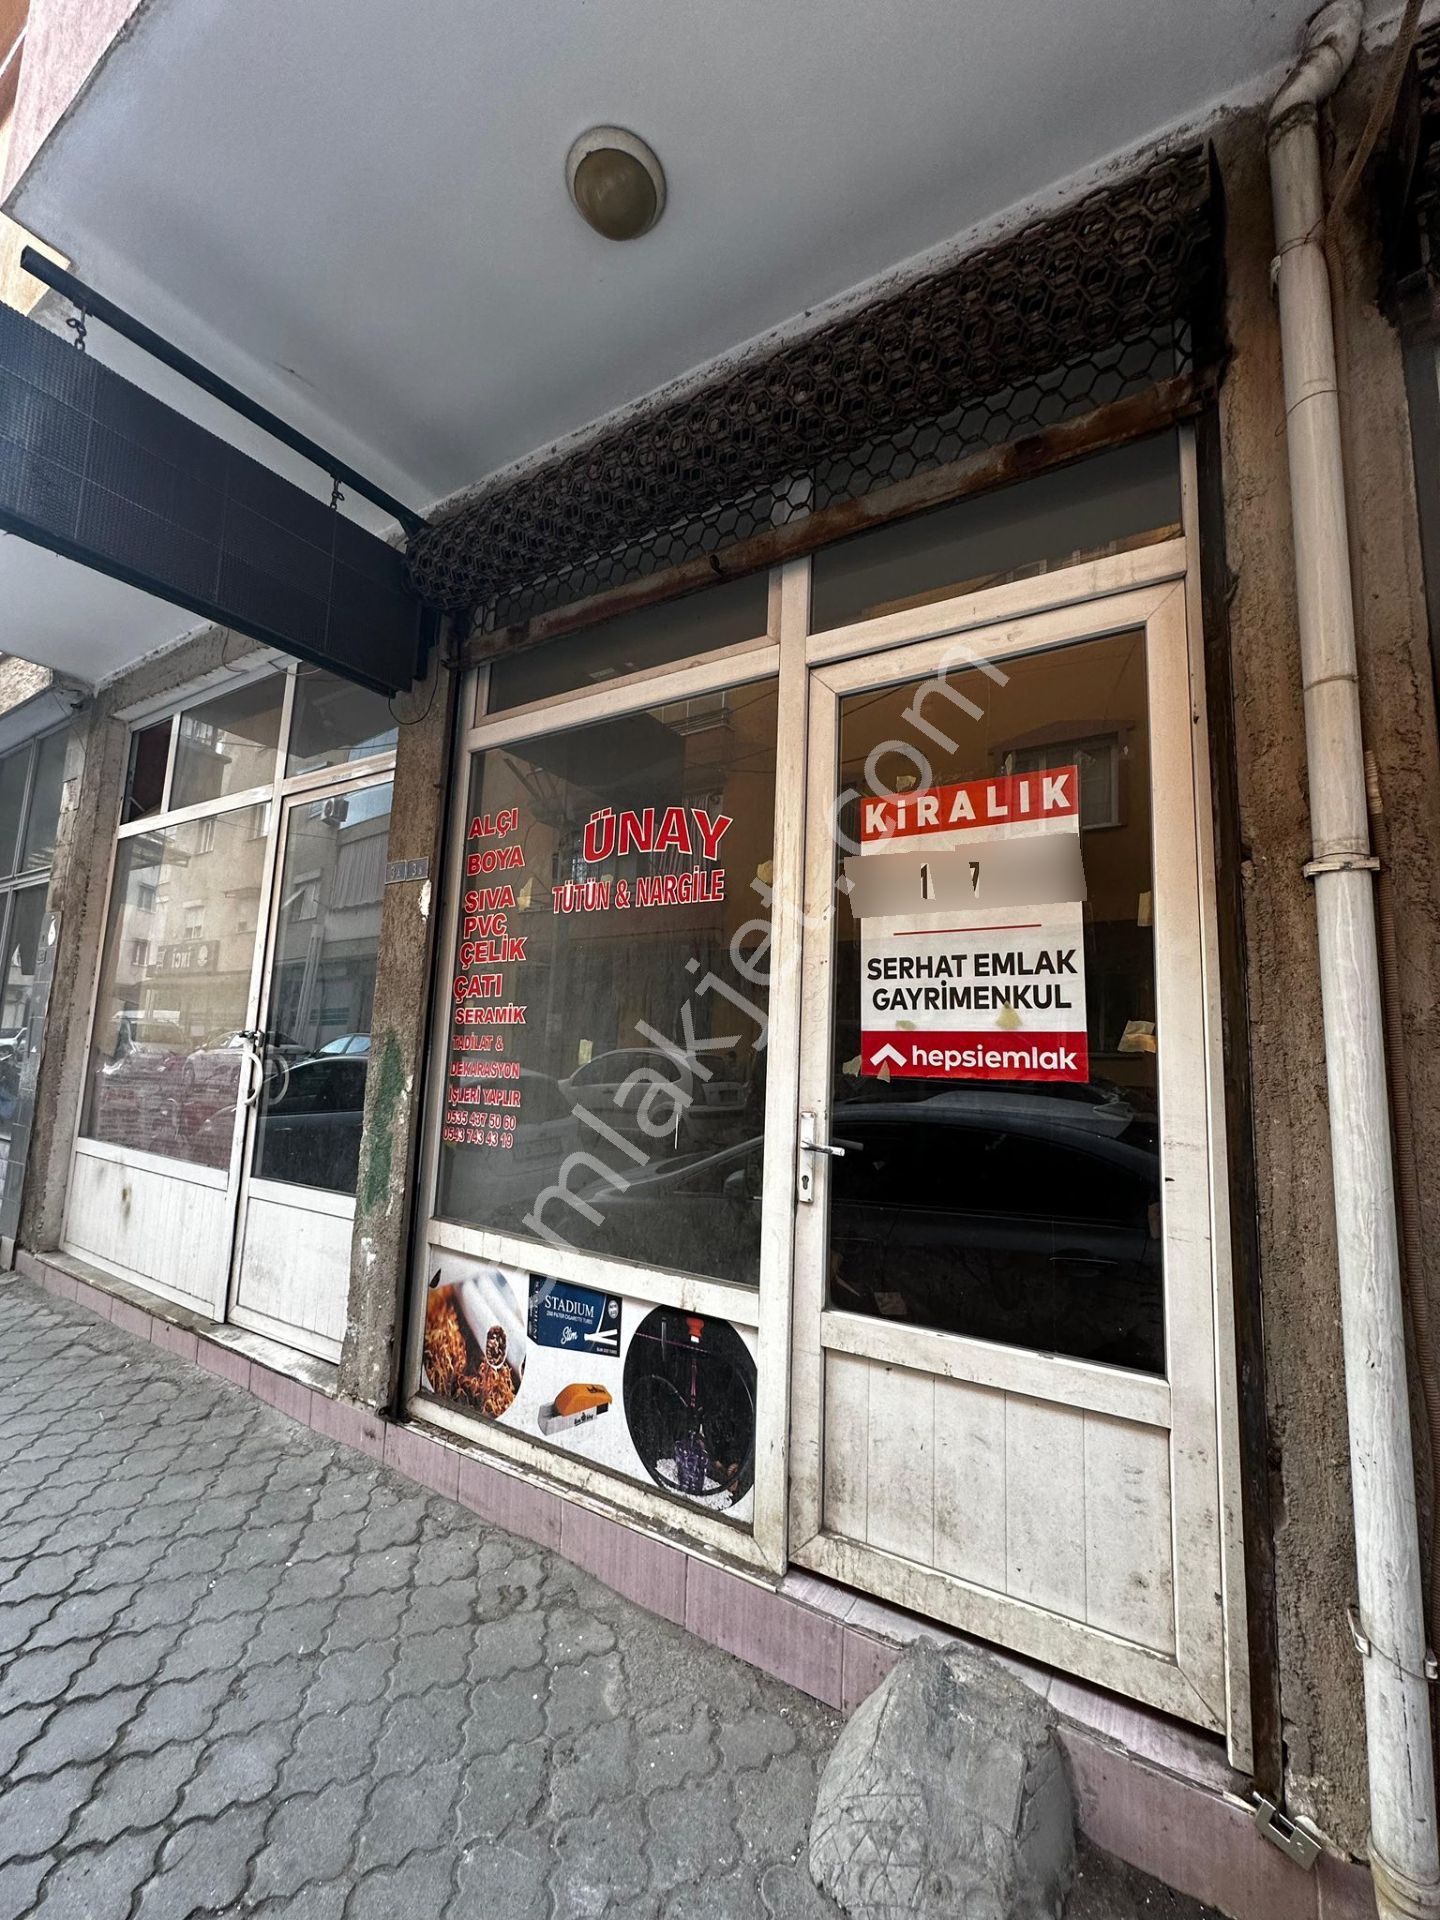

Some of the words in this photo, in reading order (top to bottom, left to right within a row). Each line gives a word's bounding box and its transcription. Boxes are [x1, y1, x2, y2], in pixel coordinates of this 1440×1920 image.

[467, 807, 519, 840] ALÇI
[583, 806, 734, 864] ÜNAY
[467, 845, 525, 877] BOYA
[464, 884, 516, 914] SIVA
[552, 876, 612, 915] TÜTÜN
[615, 879, 631, 909] &
[635, 865, 726, 908] NARGİLE
[463, 913, 508, 940] PVC
[460, 934, 528, 970] ÇELİK
[867, 953, 968, 981] SERHAT
[974, 949, 1078, 977] EMLAK
[453, 974, 503, 1004] ÇATI
[872, 980, 1073, 1012] GAYRİMENKUL
[455, 1003, 527, 1025] SERAMİK
[452, 1032, 493, 1051] TADİLAT
[495, 1035, 504, 1051] &
[450, 1061, 520, 1079] DEKARASYON
[911, 1044, 1078, 1072] hepsiemlak
[448, 1083, 480, 1106] İŞLERİ
[482, 1088, 520, 1107] YAPLIR
[489, 1113, 501, 1129] 50
[503, 1115, 516, 1131] 60
[545, 1294, 595, 1318] STADIUM
